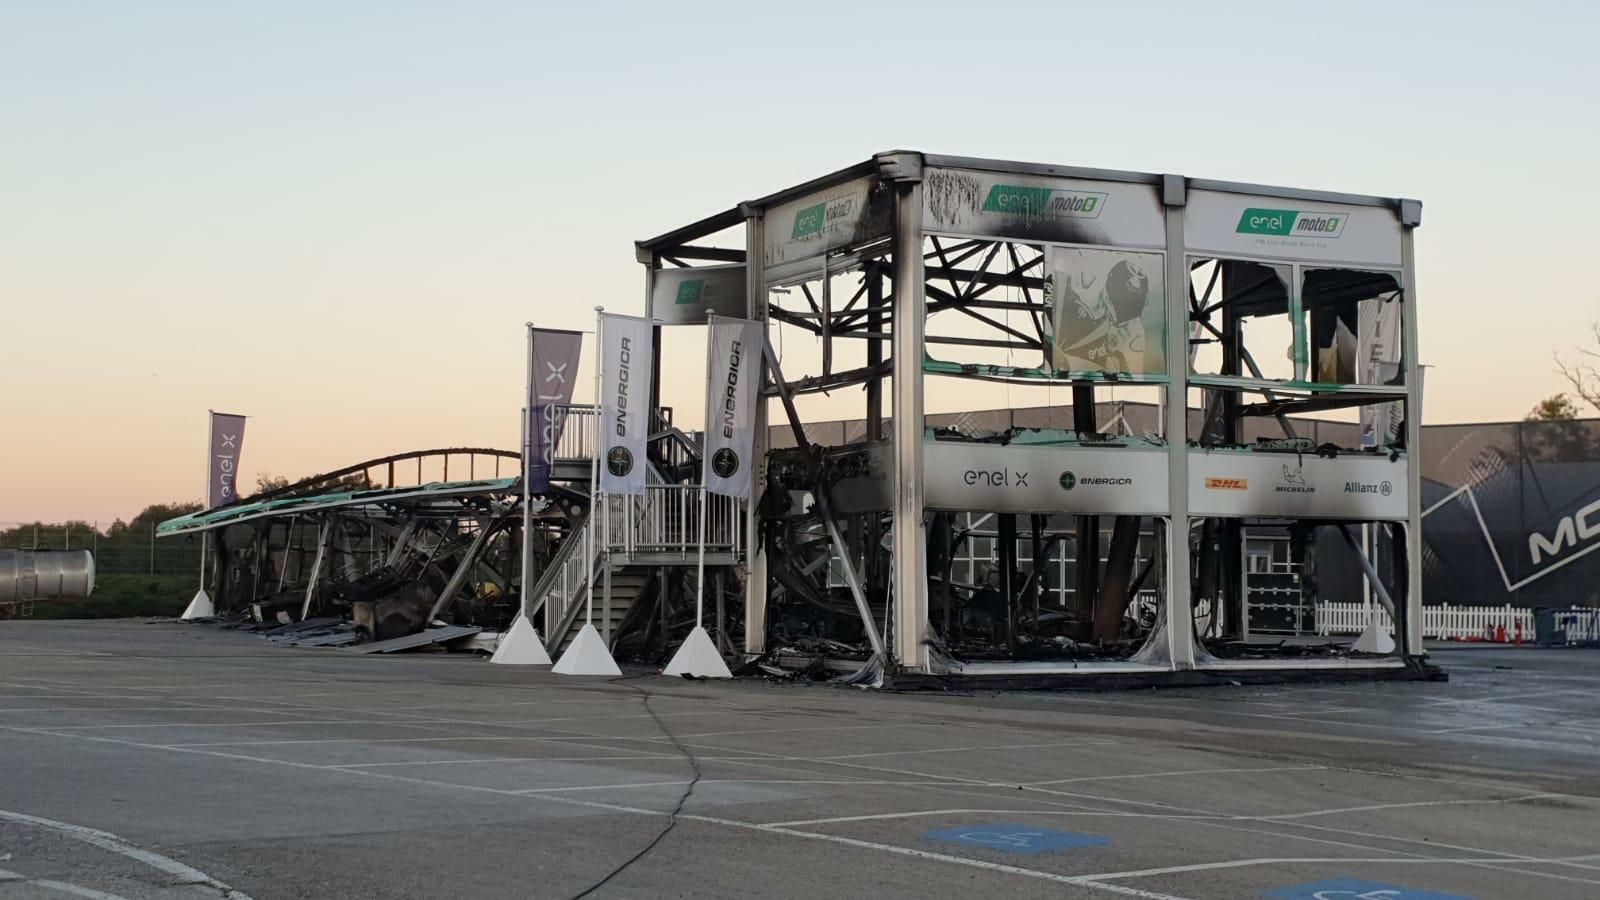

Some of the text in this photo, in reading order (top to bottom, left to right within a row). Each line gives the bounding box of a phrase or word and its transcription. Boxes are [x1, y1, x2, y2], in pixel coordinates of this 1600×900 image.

[1250, 214, 1282, 230] enel
[218, 454, 233, 498] enel
[964, 467, 1008, 486] enel
[1211, 479, 1241, 488] DHL
[1344, 481, 1378, 493] Allianz
